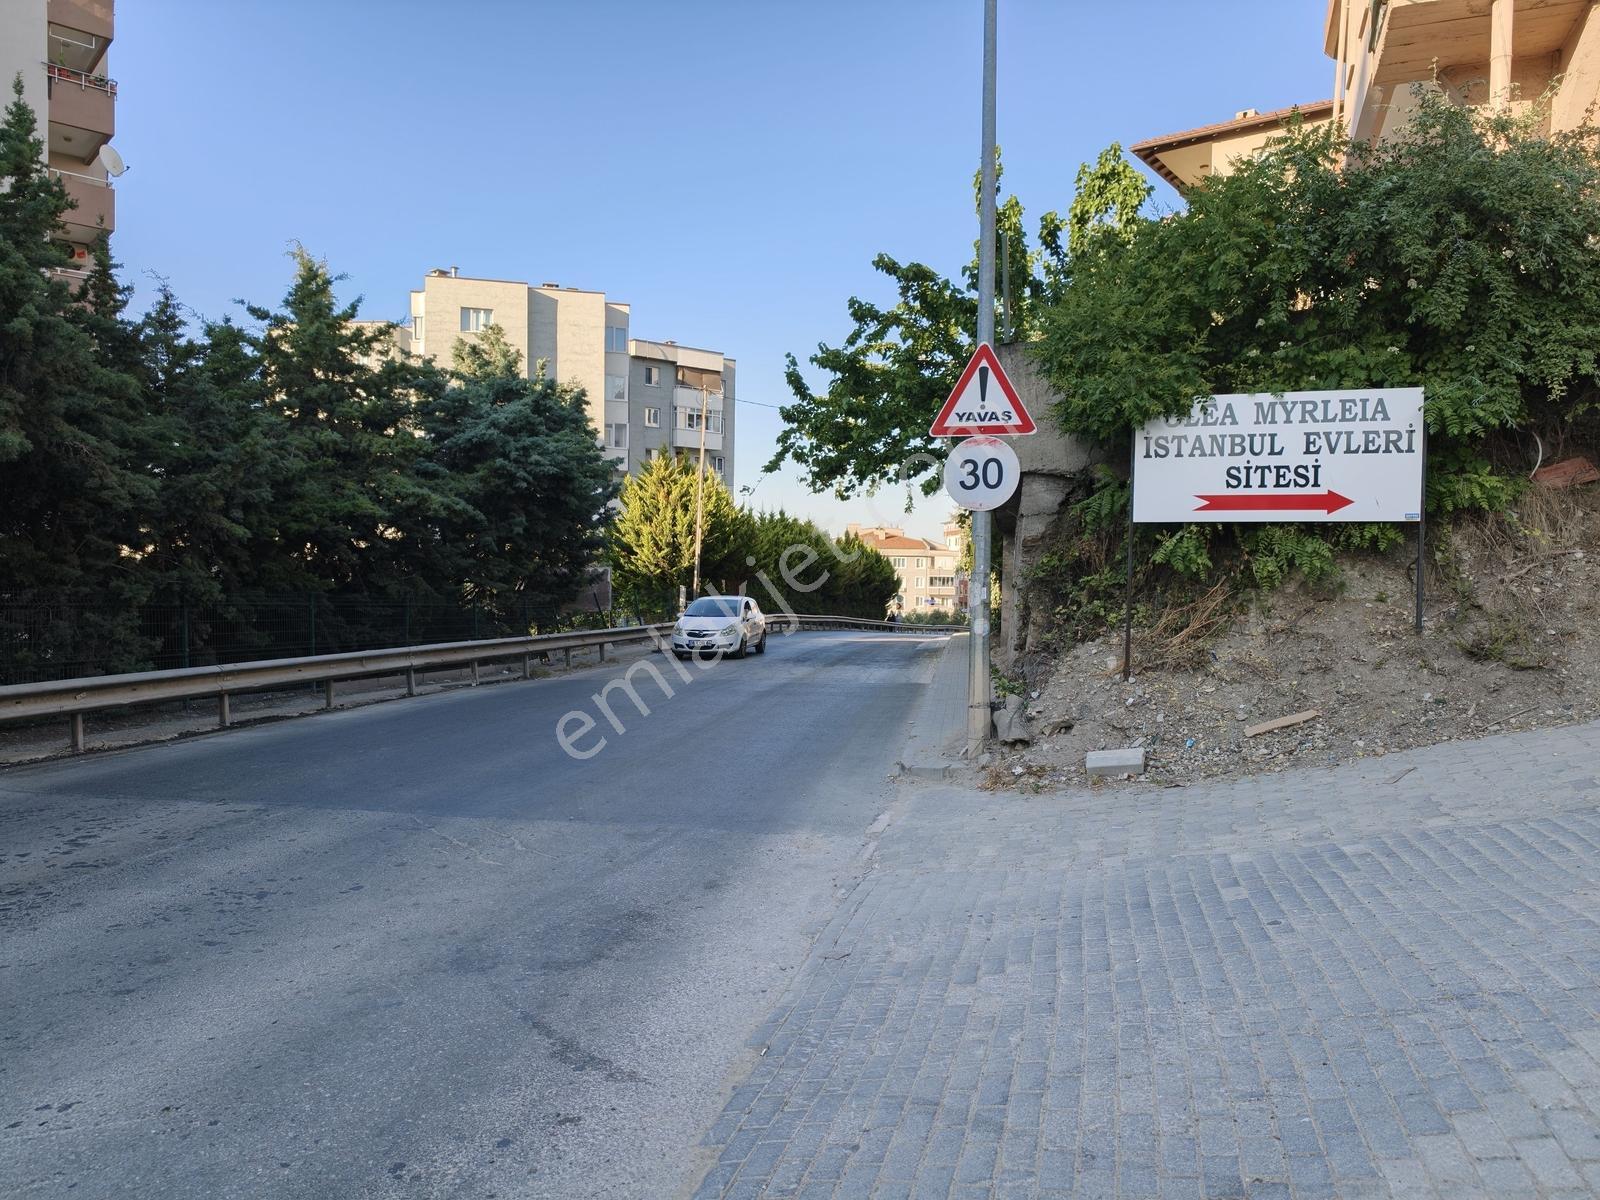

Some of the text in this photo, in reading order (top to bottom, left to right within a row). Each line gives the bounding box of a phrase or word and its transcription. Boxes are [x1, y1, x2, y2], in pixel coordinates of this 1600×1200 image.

[1253, 398, 1391, 425] MYRLEIA
[1143, 423, 1416, 459] İSTANBUL EVLERİ
[959, 457, 1004, 491] 30
[1225, 458, 1322, 489] SİTESİ
